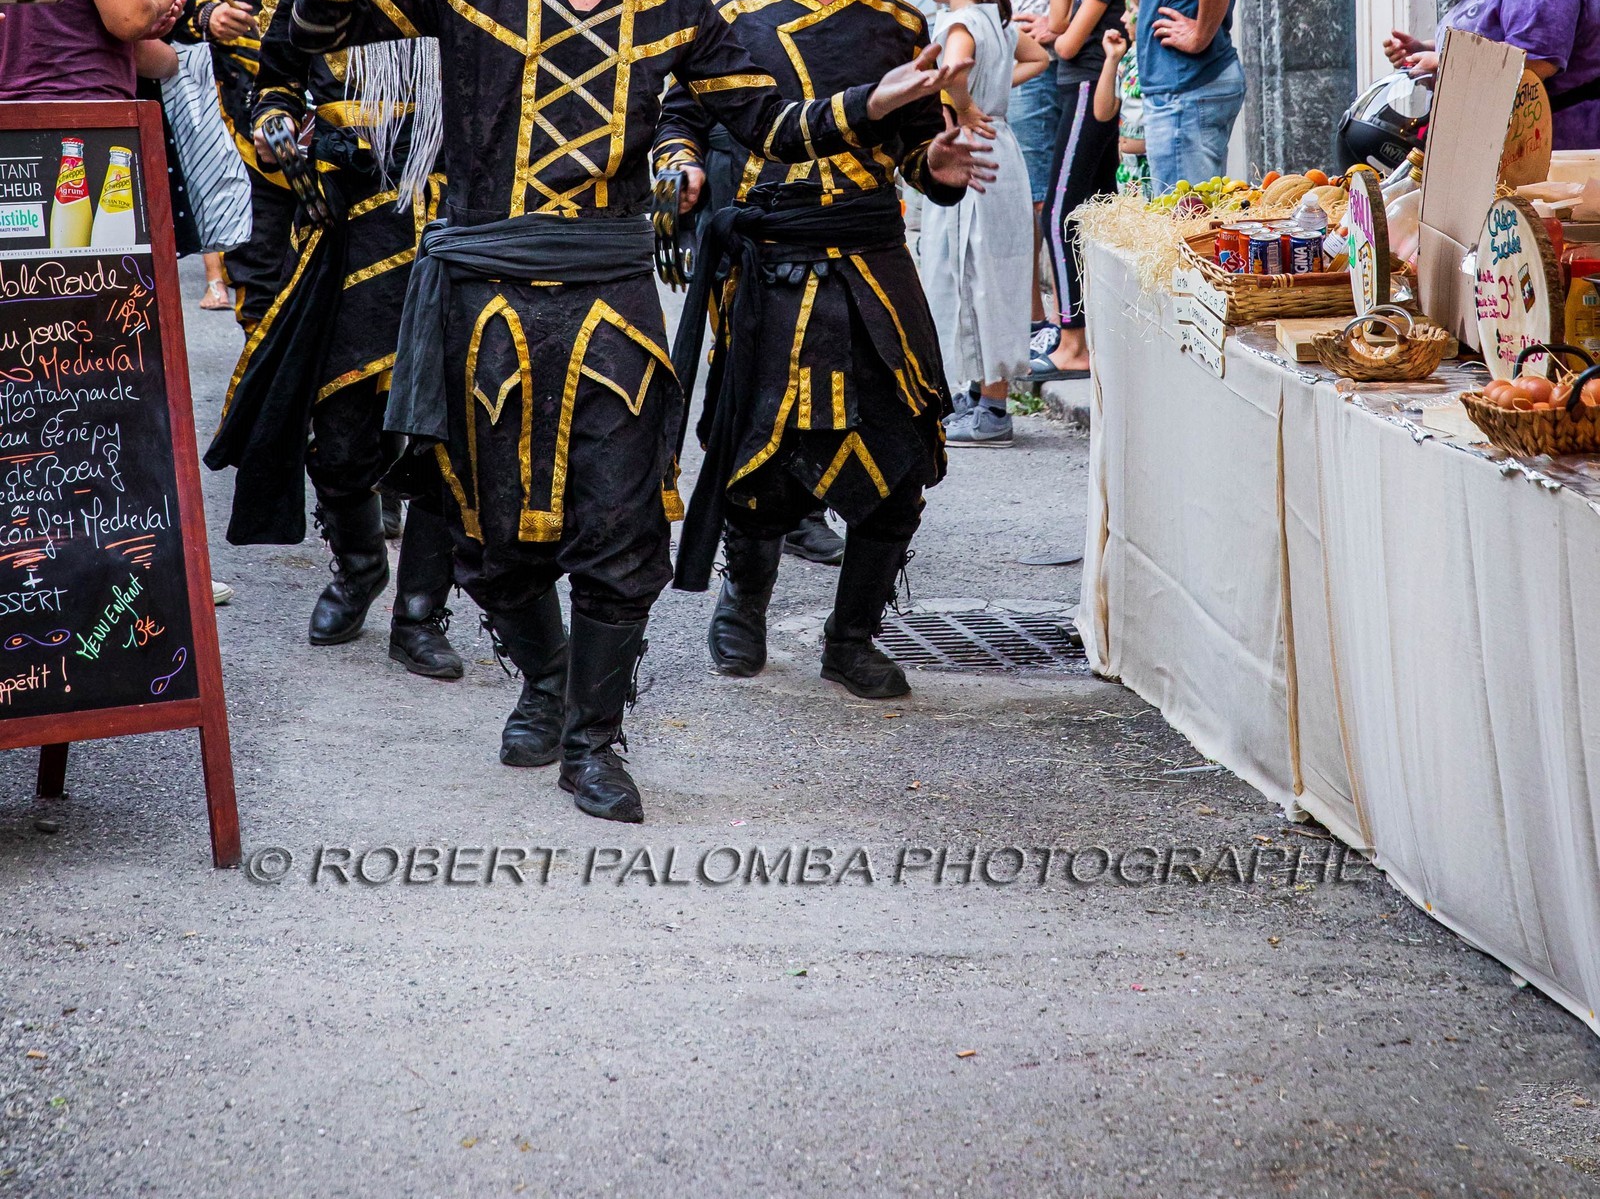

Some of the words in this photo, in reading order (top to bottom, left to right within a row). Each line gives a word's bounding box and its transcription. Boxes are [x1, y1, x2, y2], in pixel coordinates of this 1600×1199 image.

[0, 163, 39, 180] TANT
[0, 209, 39, 228] istible
[1294, 246, 1309, 274] GINA
[0, 261, 39, 298] ble
[5, 462, 37, 487] de
[0, 484, 63, 505] edieval
[11, 505, 30, 518] ou
[0, 586, 69, 616] SSERT
[0, 663, 51, 705] ppétit
